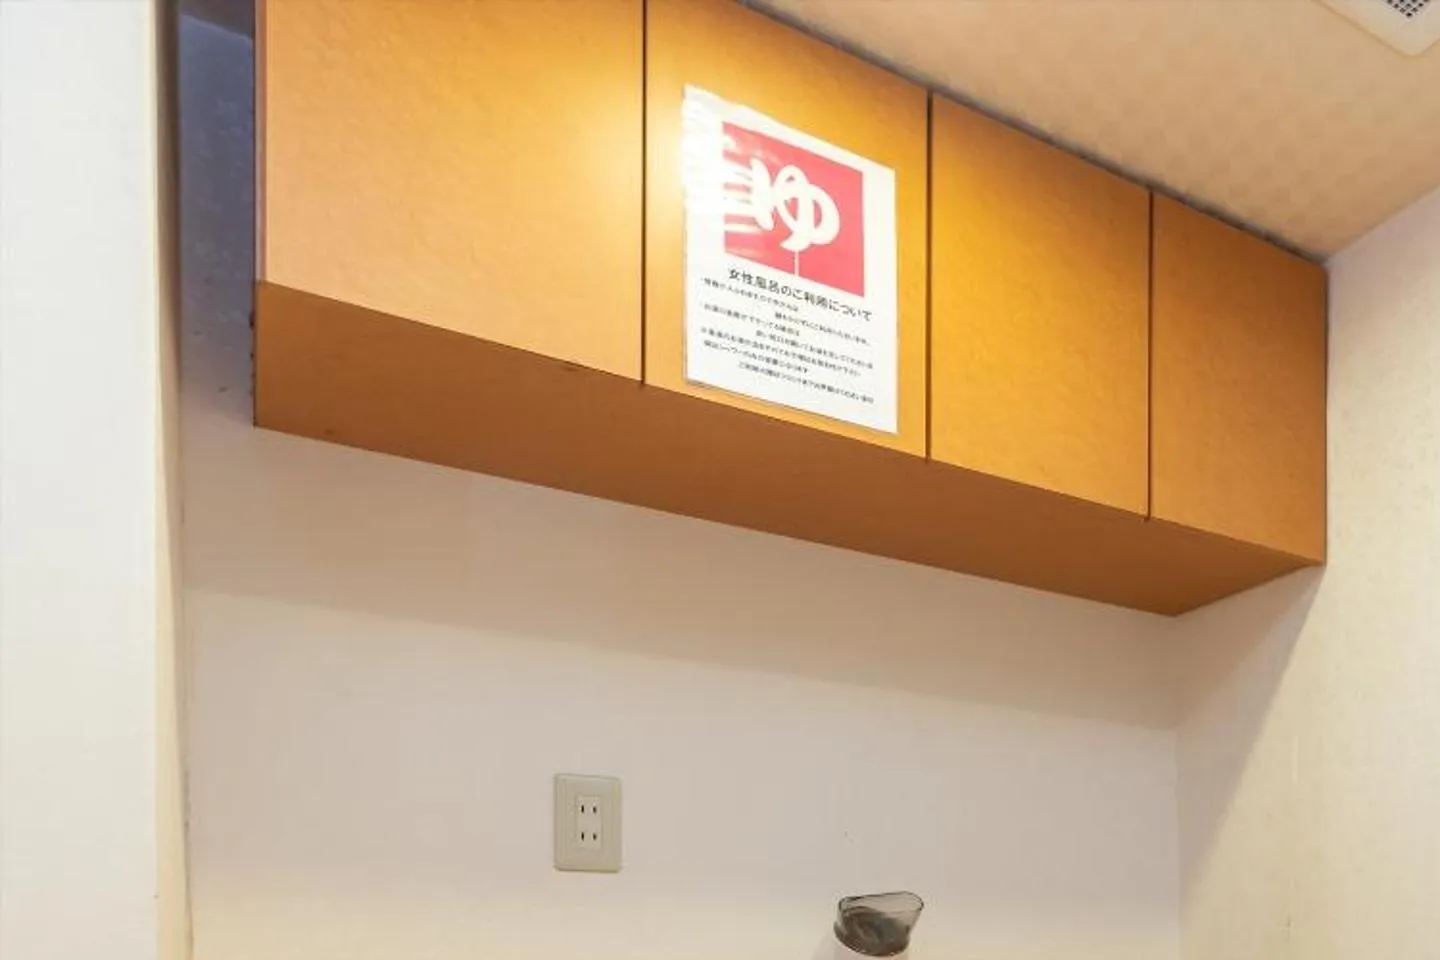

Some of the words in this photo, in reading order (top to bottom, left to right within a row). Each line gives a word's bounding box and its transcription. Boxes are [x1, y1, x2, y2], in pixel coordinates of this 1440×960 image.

[750, 156, 840, 252] ゆ
[728, 268, 873, 322] 女性風呂のご利用について
